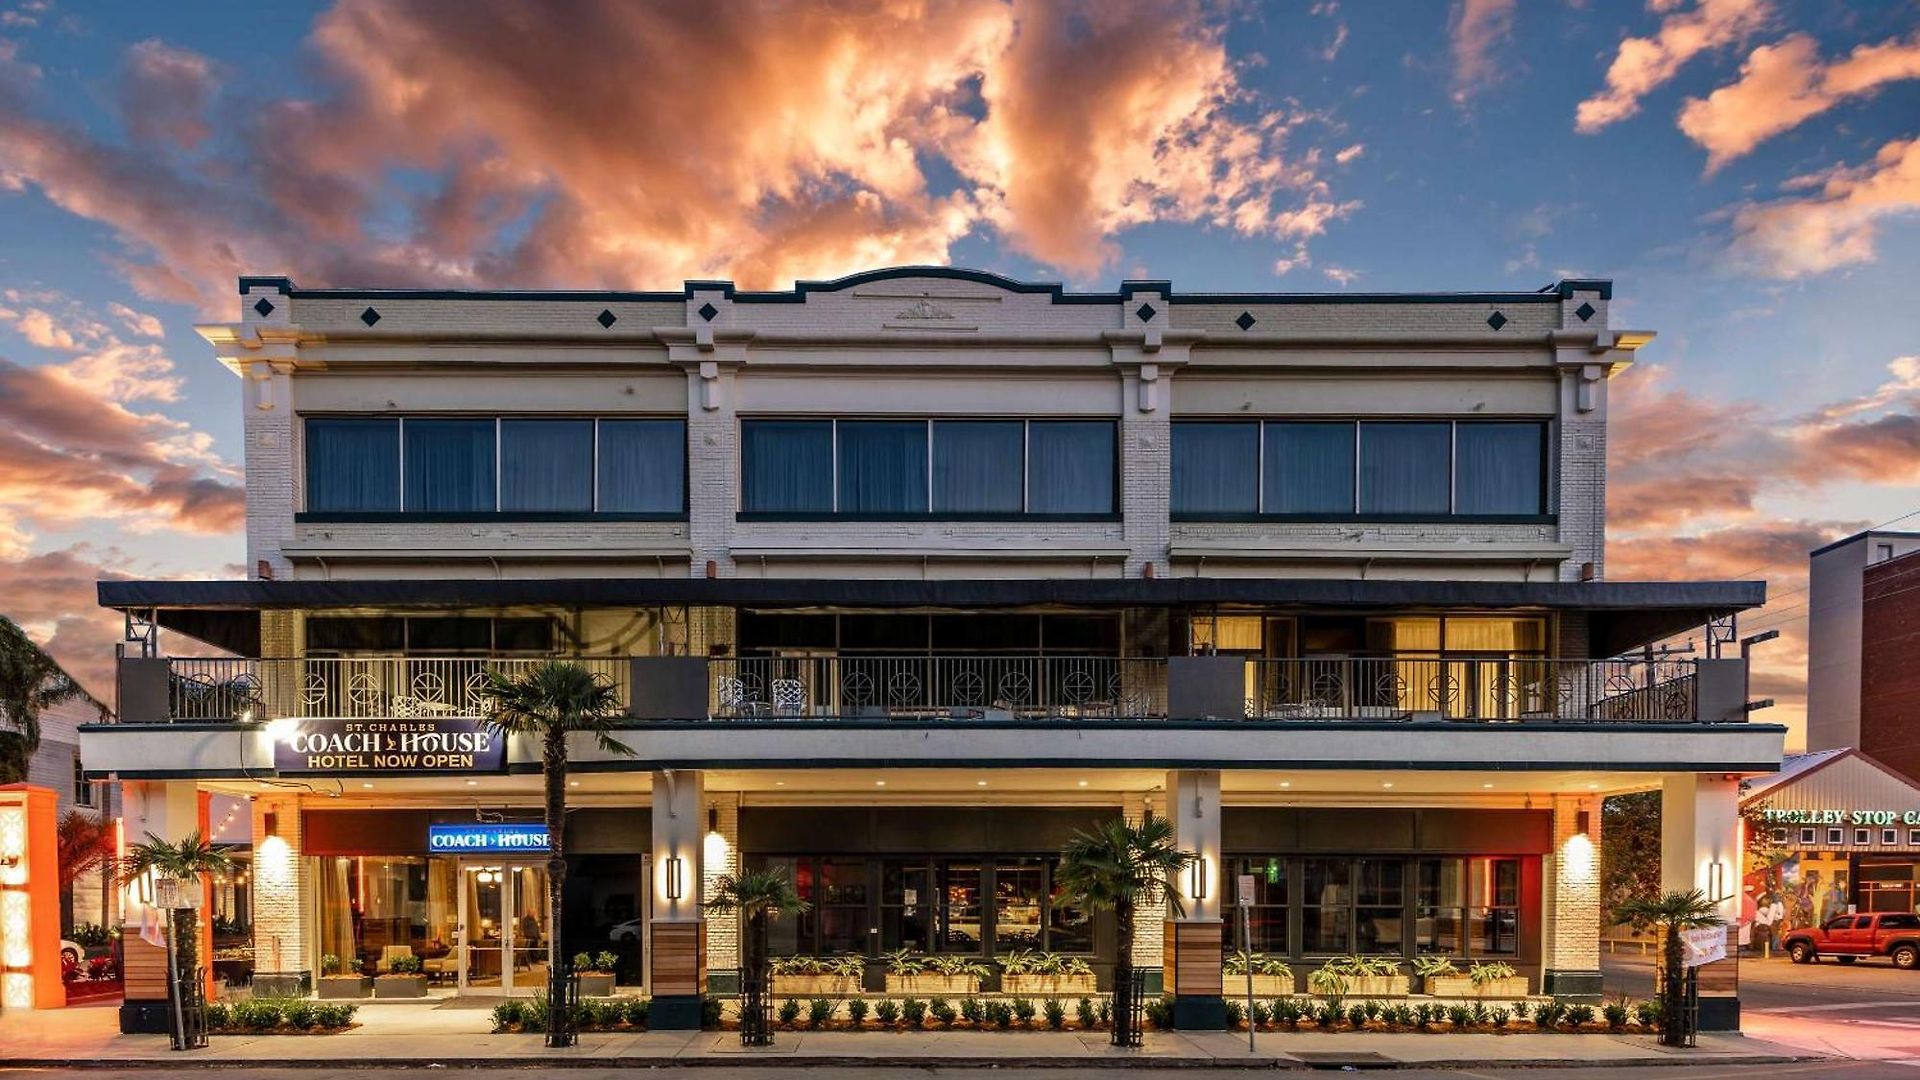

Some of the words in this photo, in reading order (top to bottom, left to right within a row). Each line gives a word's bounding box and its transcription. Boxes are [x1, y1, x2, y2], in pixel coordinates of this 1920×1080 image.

[346, 723, 365, 731] ST.
[369, 723, 435, 732] CHARLES
[291, 732, 380, 753] COACH
[401, 732, 490, 753] HOUSE
[307, 754, 369, 768] HOTEL
[374, 754, 418, 768] NOW
[422, 754, 473, 768] OPEN
[1764, 808, 1845, 824] TROLLEY
[1852, 810, 1897, 825] STOP
[432, 833, 488, 848] COACH
